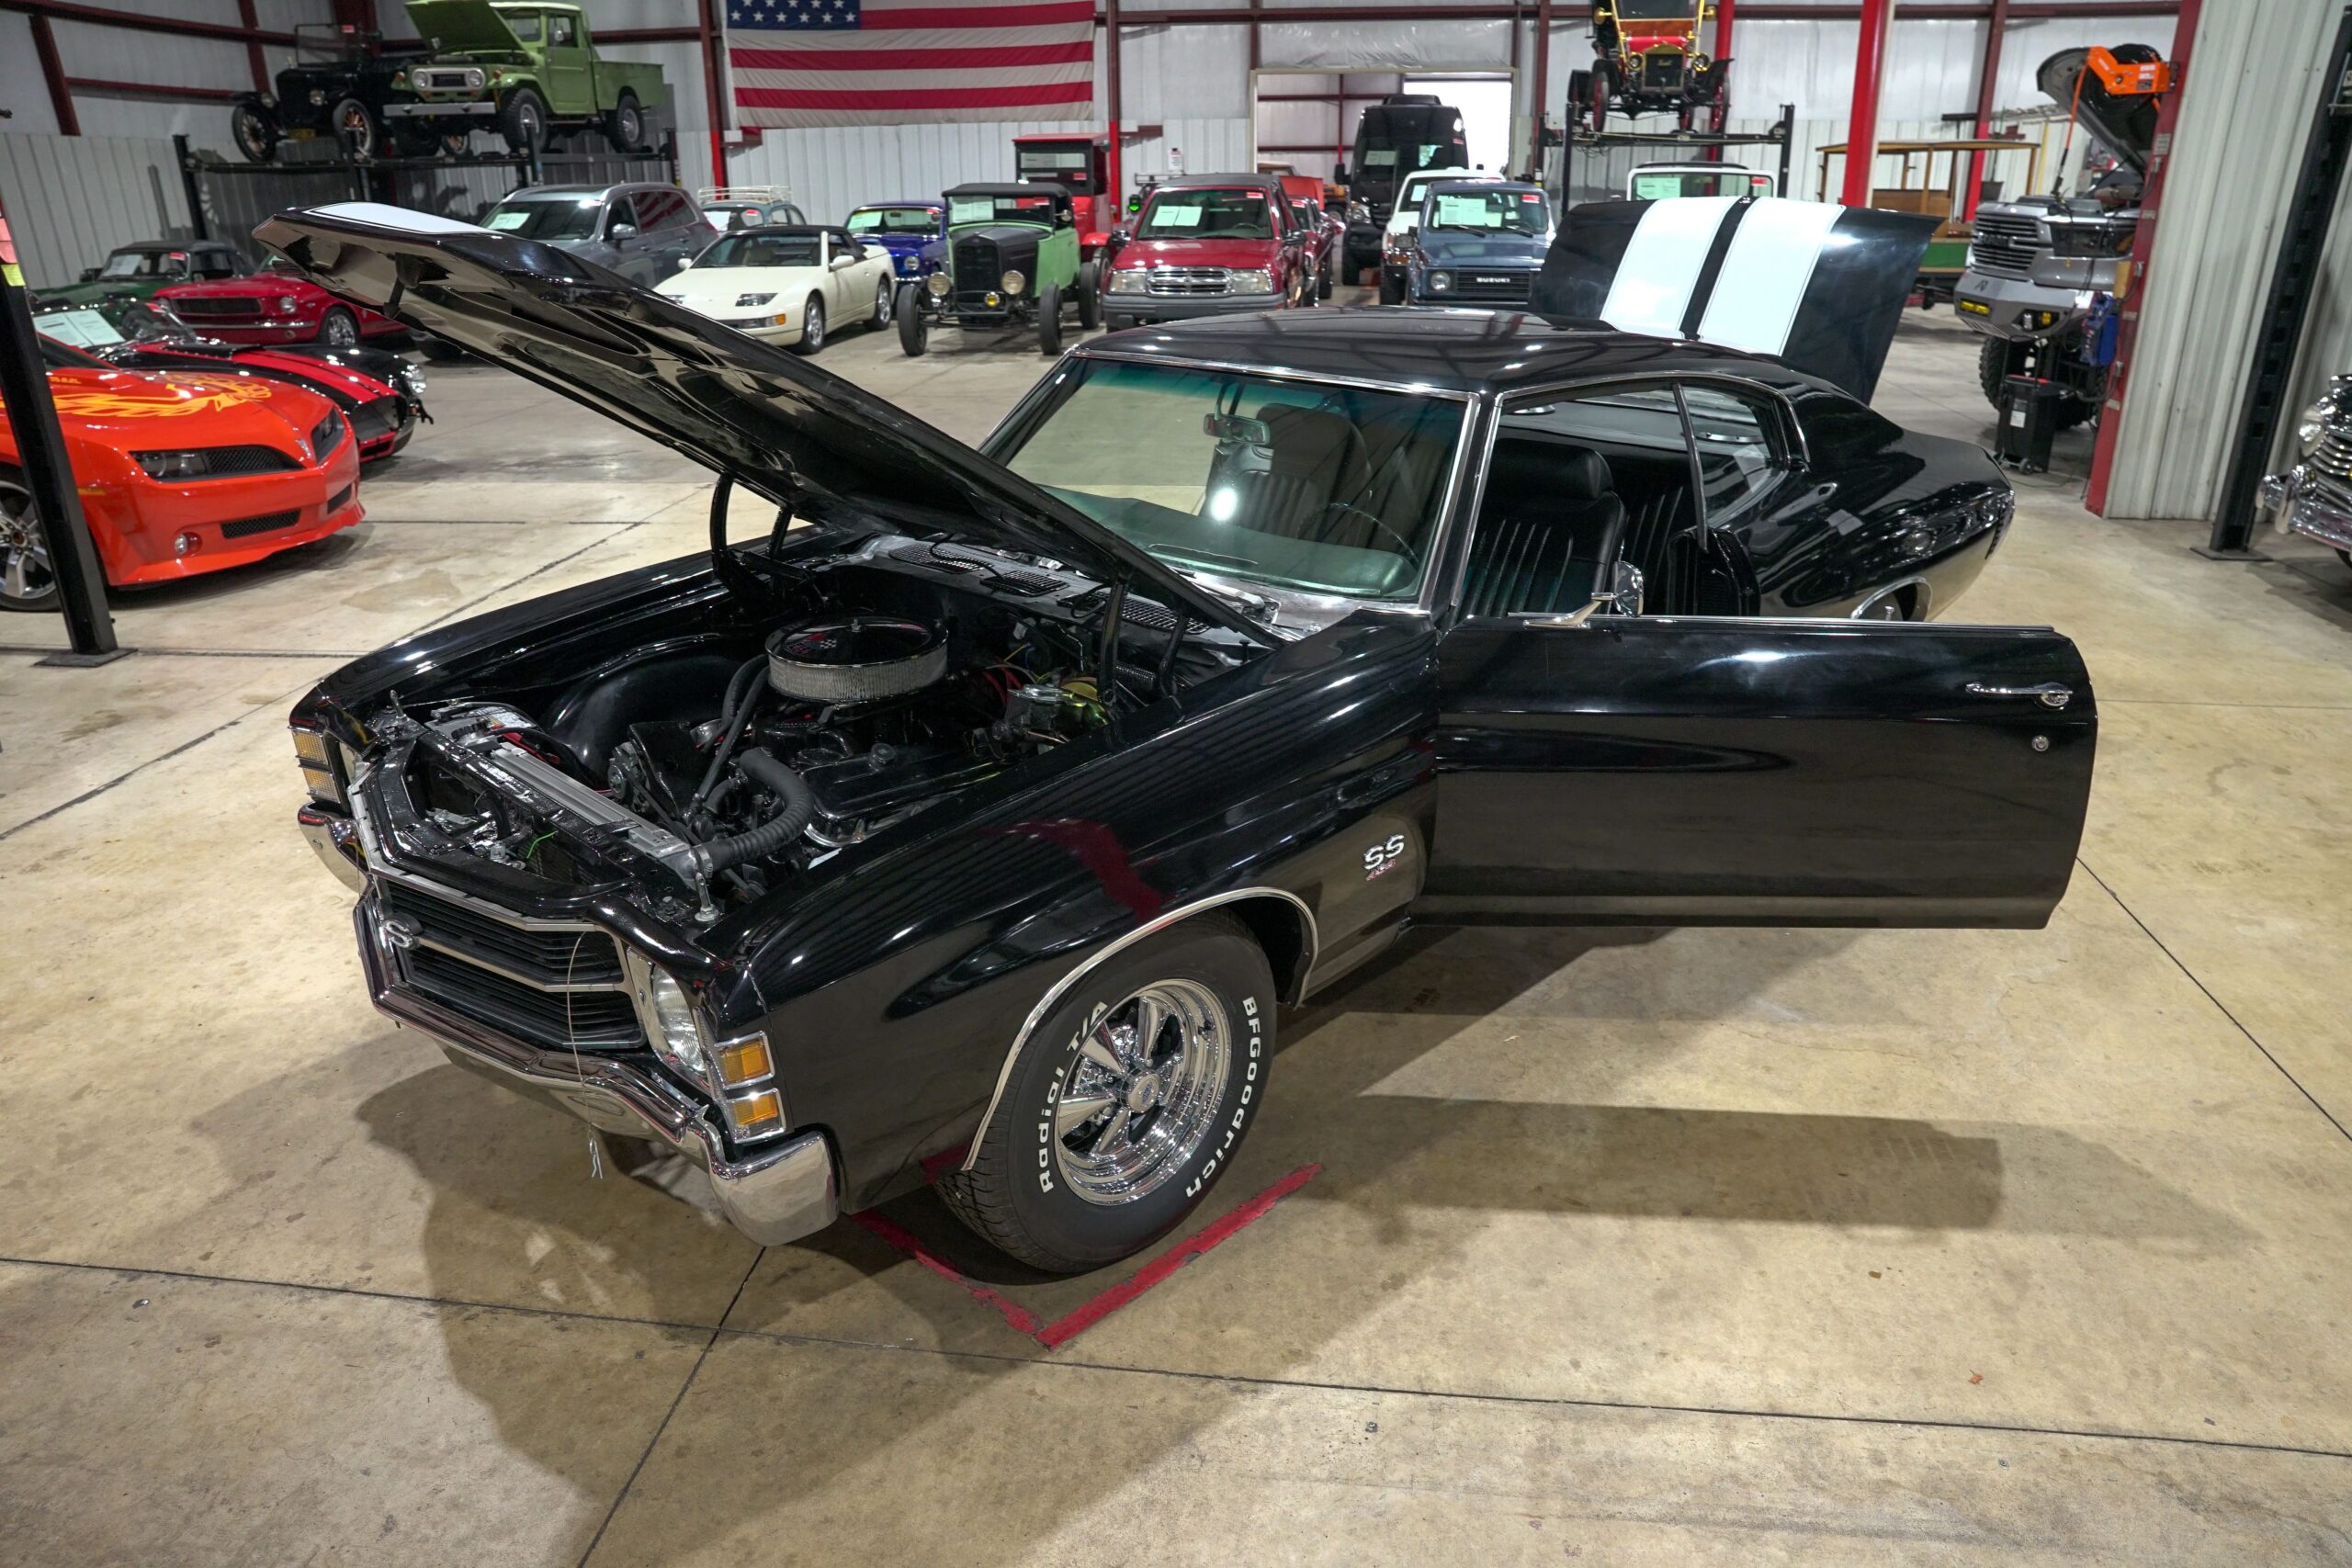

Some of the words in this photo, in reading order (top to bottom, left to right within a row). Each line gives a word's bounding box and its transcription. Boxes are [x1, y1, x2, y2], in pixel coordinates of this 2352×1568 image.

[1363, 834, 1405, 870] SS
[1038, 1066, 1065, 1193] Radial
[1185, 997, 1261, 1198] BFGoodrich
